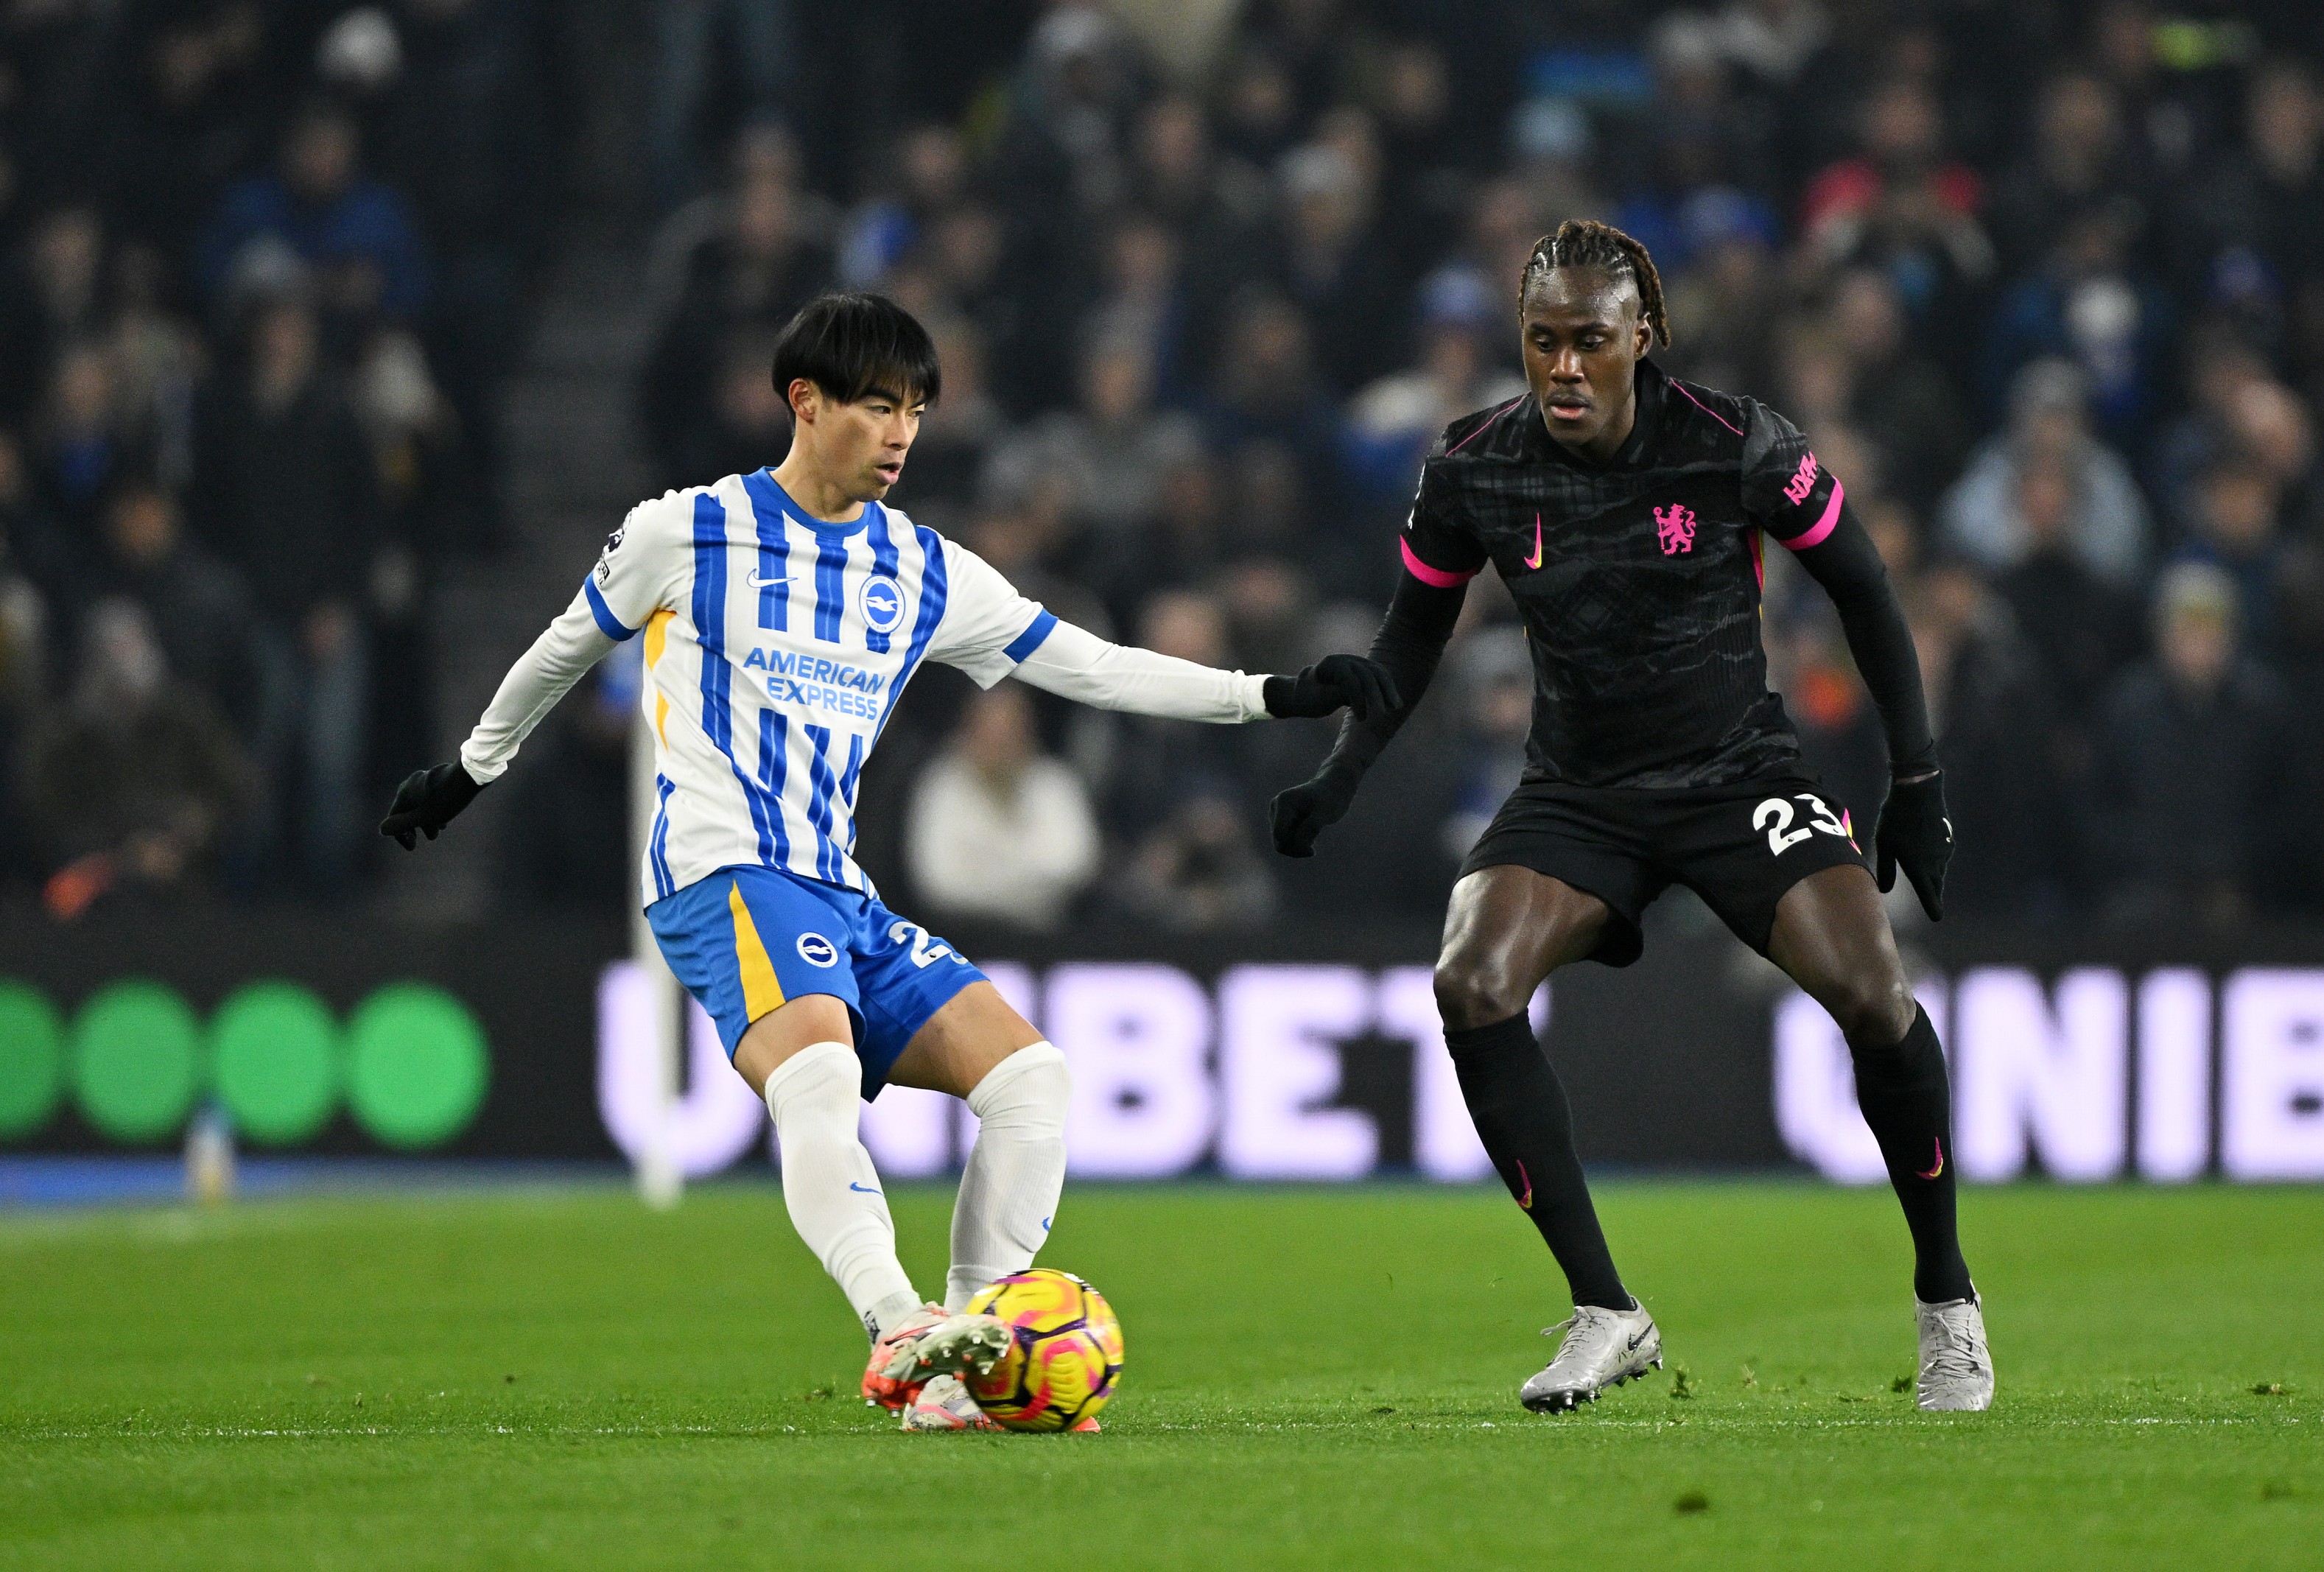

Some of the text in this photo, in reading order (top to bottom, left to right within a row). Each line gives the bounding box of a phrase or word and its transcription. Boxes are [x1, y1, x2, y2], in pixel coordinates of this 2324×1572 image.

[743, 647, 886, 695] AMERICAN
[767, 676, 879, 720] EXPRESS
[1752, 793, 1847, 856] 23
